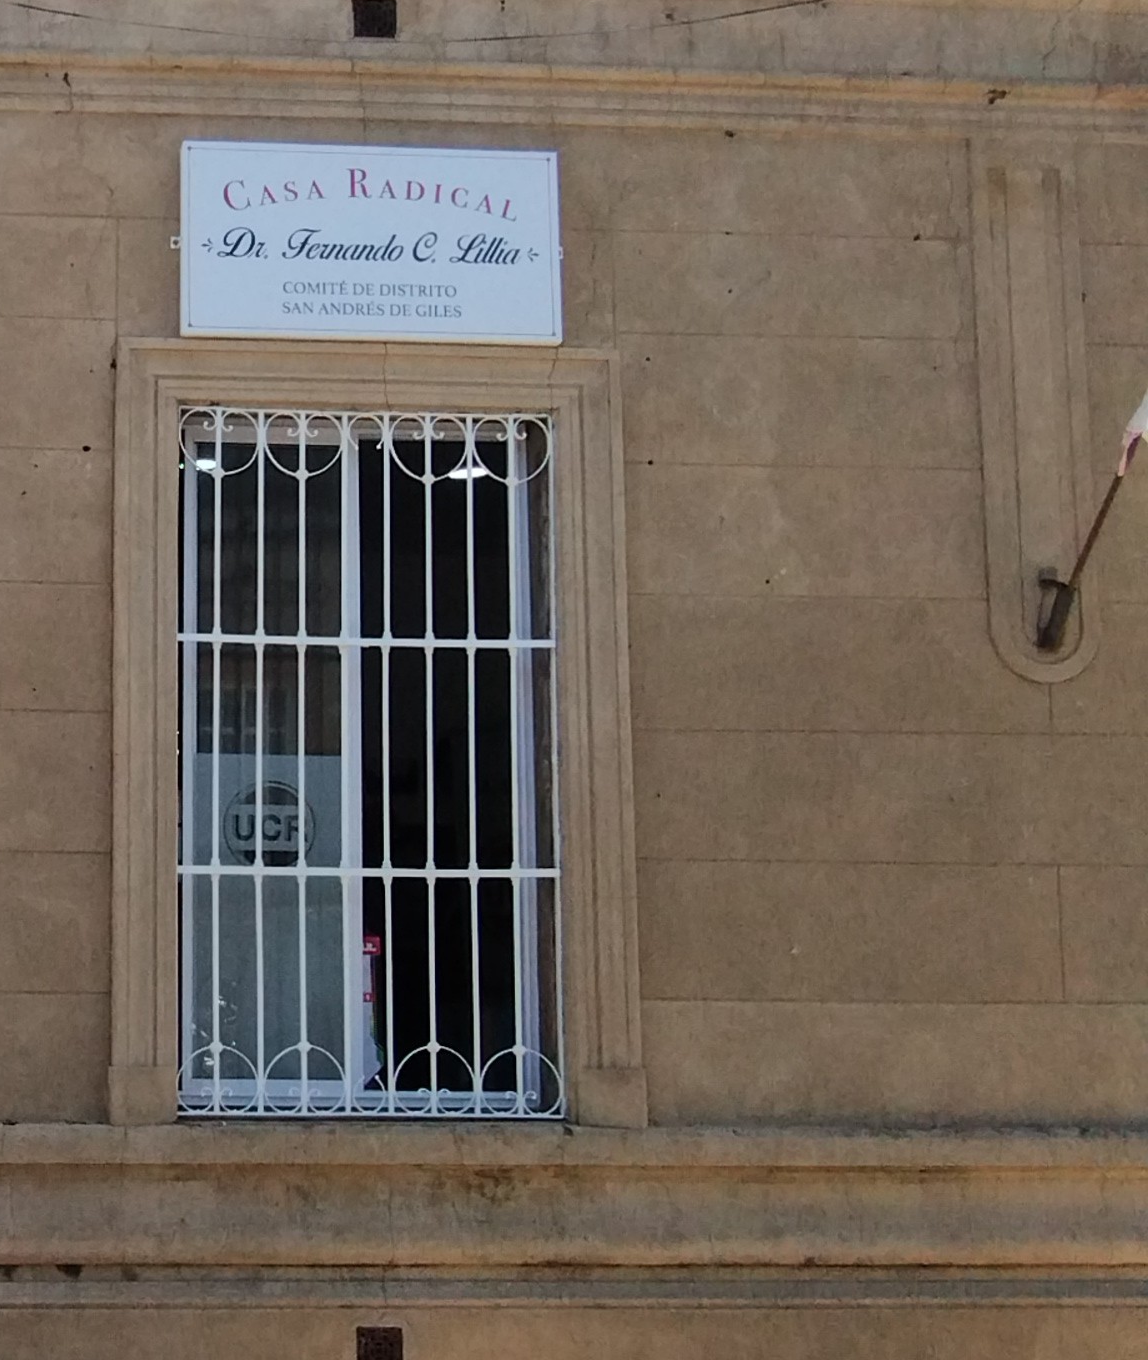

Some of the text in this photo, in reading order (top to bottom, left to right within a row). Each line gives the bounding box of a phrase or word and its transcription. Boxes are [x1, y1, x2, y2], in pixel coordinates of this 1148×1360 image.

[217, 226, 521, 265] Dr. Fernando C. Lillia
[282, 280, 457, 298] COMITÉ DE DISTRITO
[282, 301, 462, 319] SAN ANDRÉS DE GILES
